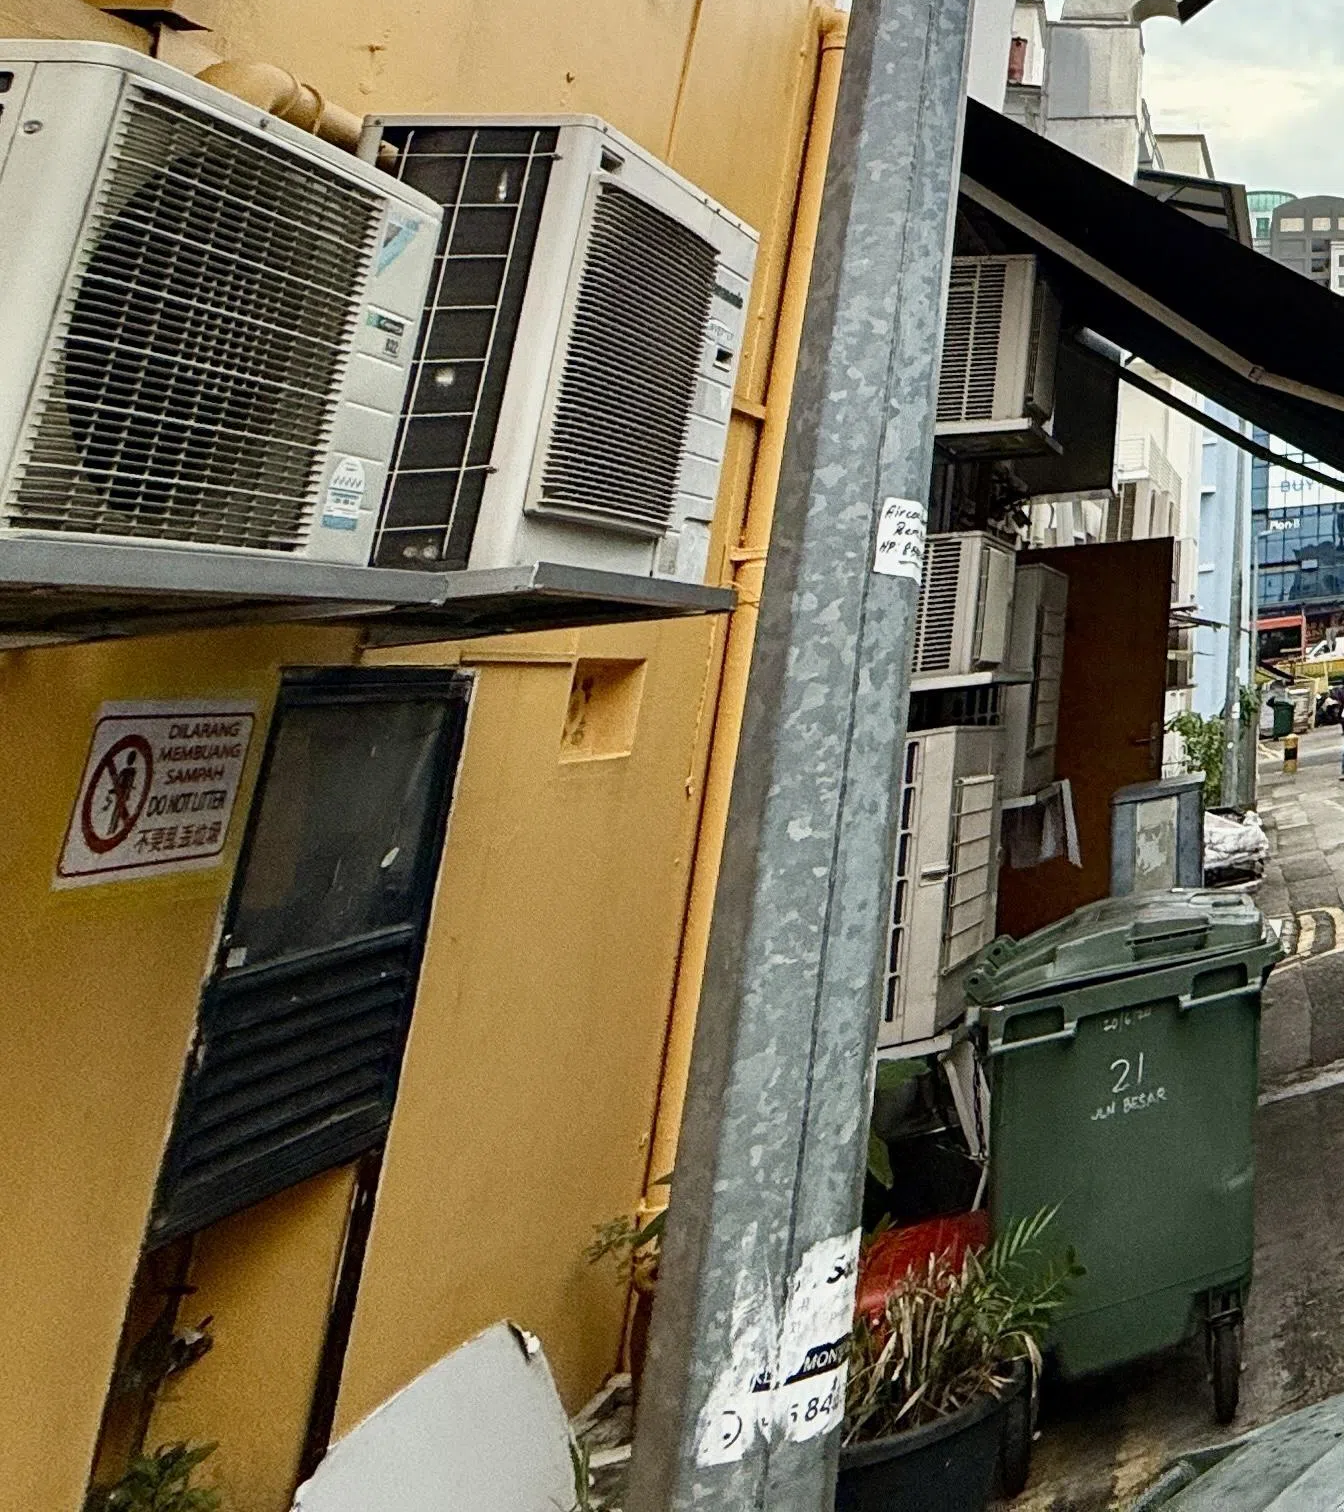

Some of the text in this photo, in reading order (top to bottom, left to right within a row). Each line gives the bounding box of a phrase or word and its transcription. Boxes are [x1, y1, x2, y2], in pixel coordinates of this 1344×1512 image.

[168, 721, 242, 740] DILARANG
[159, 743, 242, 762] MEMBUANG
[164, 764, 226, 785] SAMPAH
[146, 790, 227, 818] DO NOT LITTER
[1109, 1051, 1144, 1094] 21
